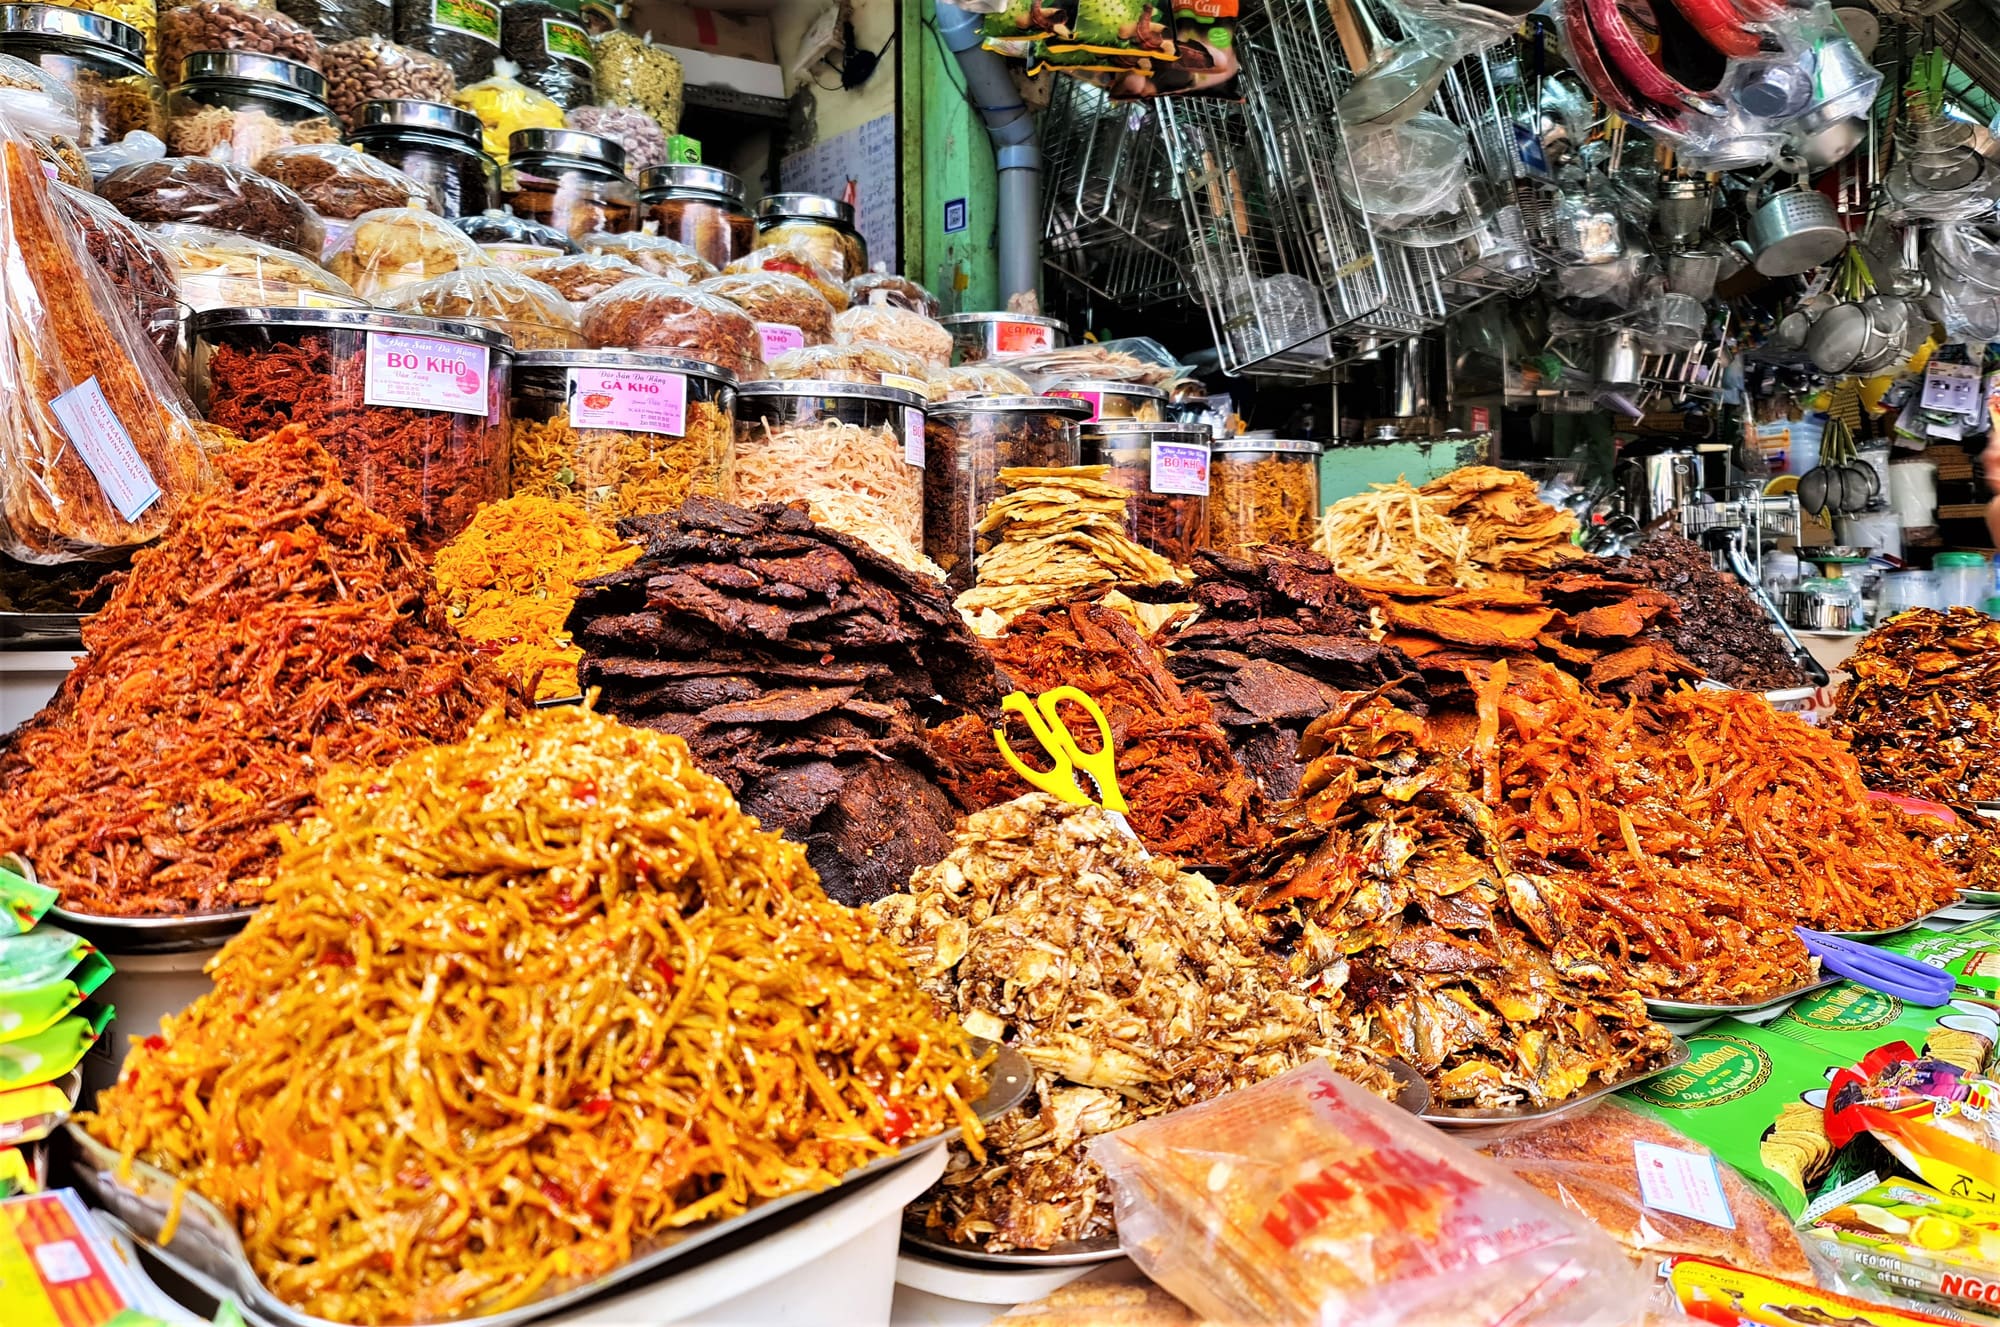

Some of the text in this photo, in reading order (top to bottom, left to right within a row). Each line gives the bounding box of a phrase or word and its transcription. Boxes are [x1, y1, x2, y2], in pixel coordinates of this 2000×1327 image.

[387, 349, 467, 376] BÒ KHÔ
[628, 383, 660, 394] KHÔ
[1648, 1044, 1749, 1097] Dừa Nướng
[1682, 1091, 1708, 1101] Đặc
[1708, 1084, 1727, 1097] sản
[1722, 1071, 1749, 1091] Quảng
